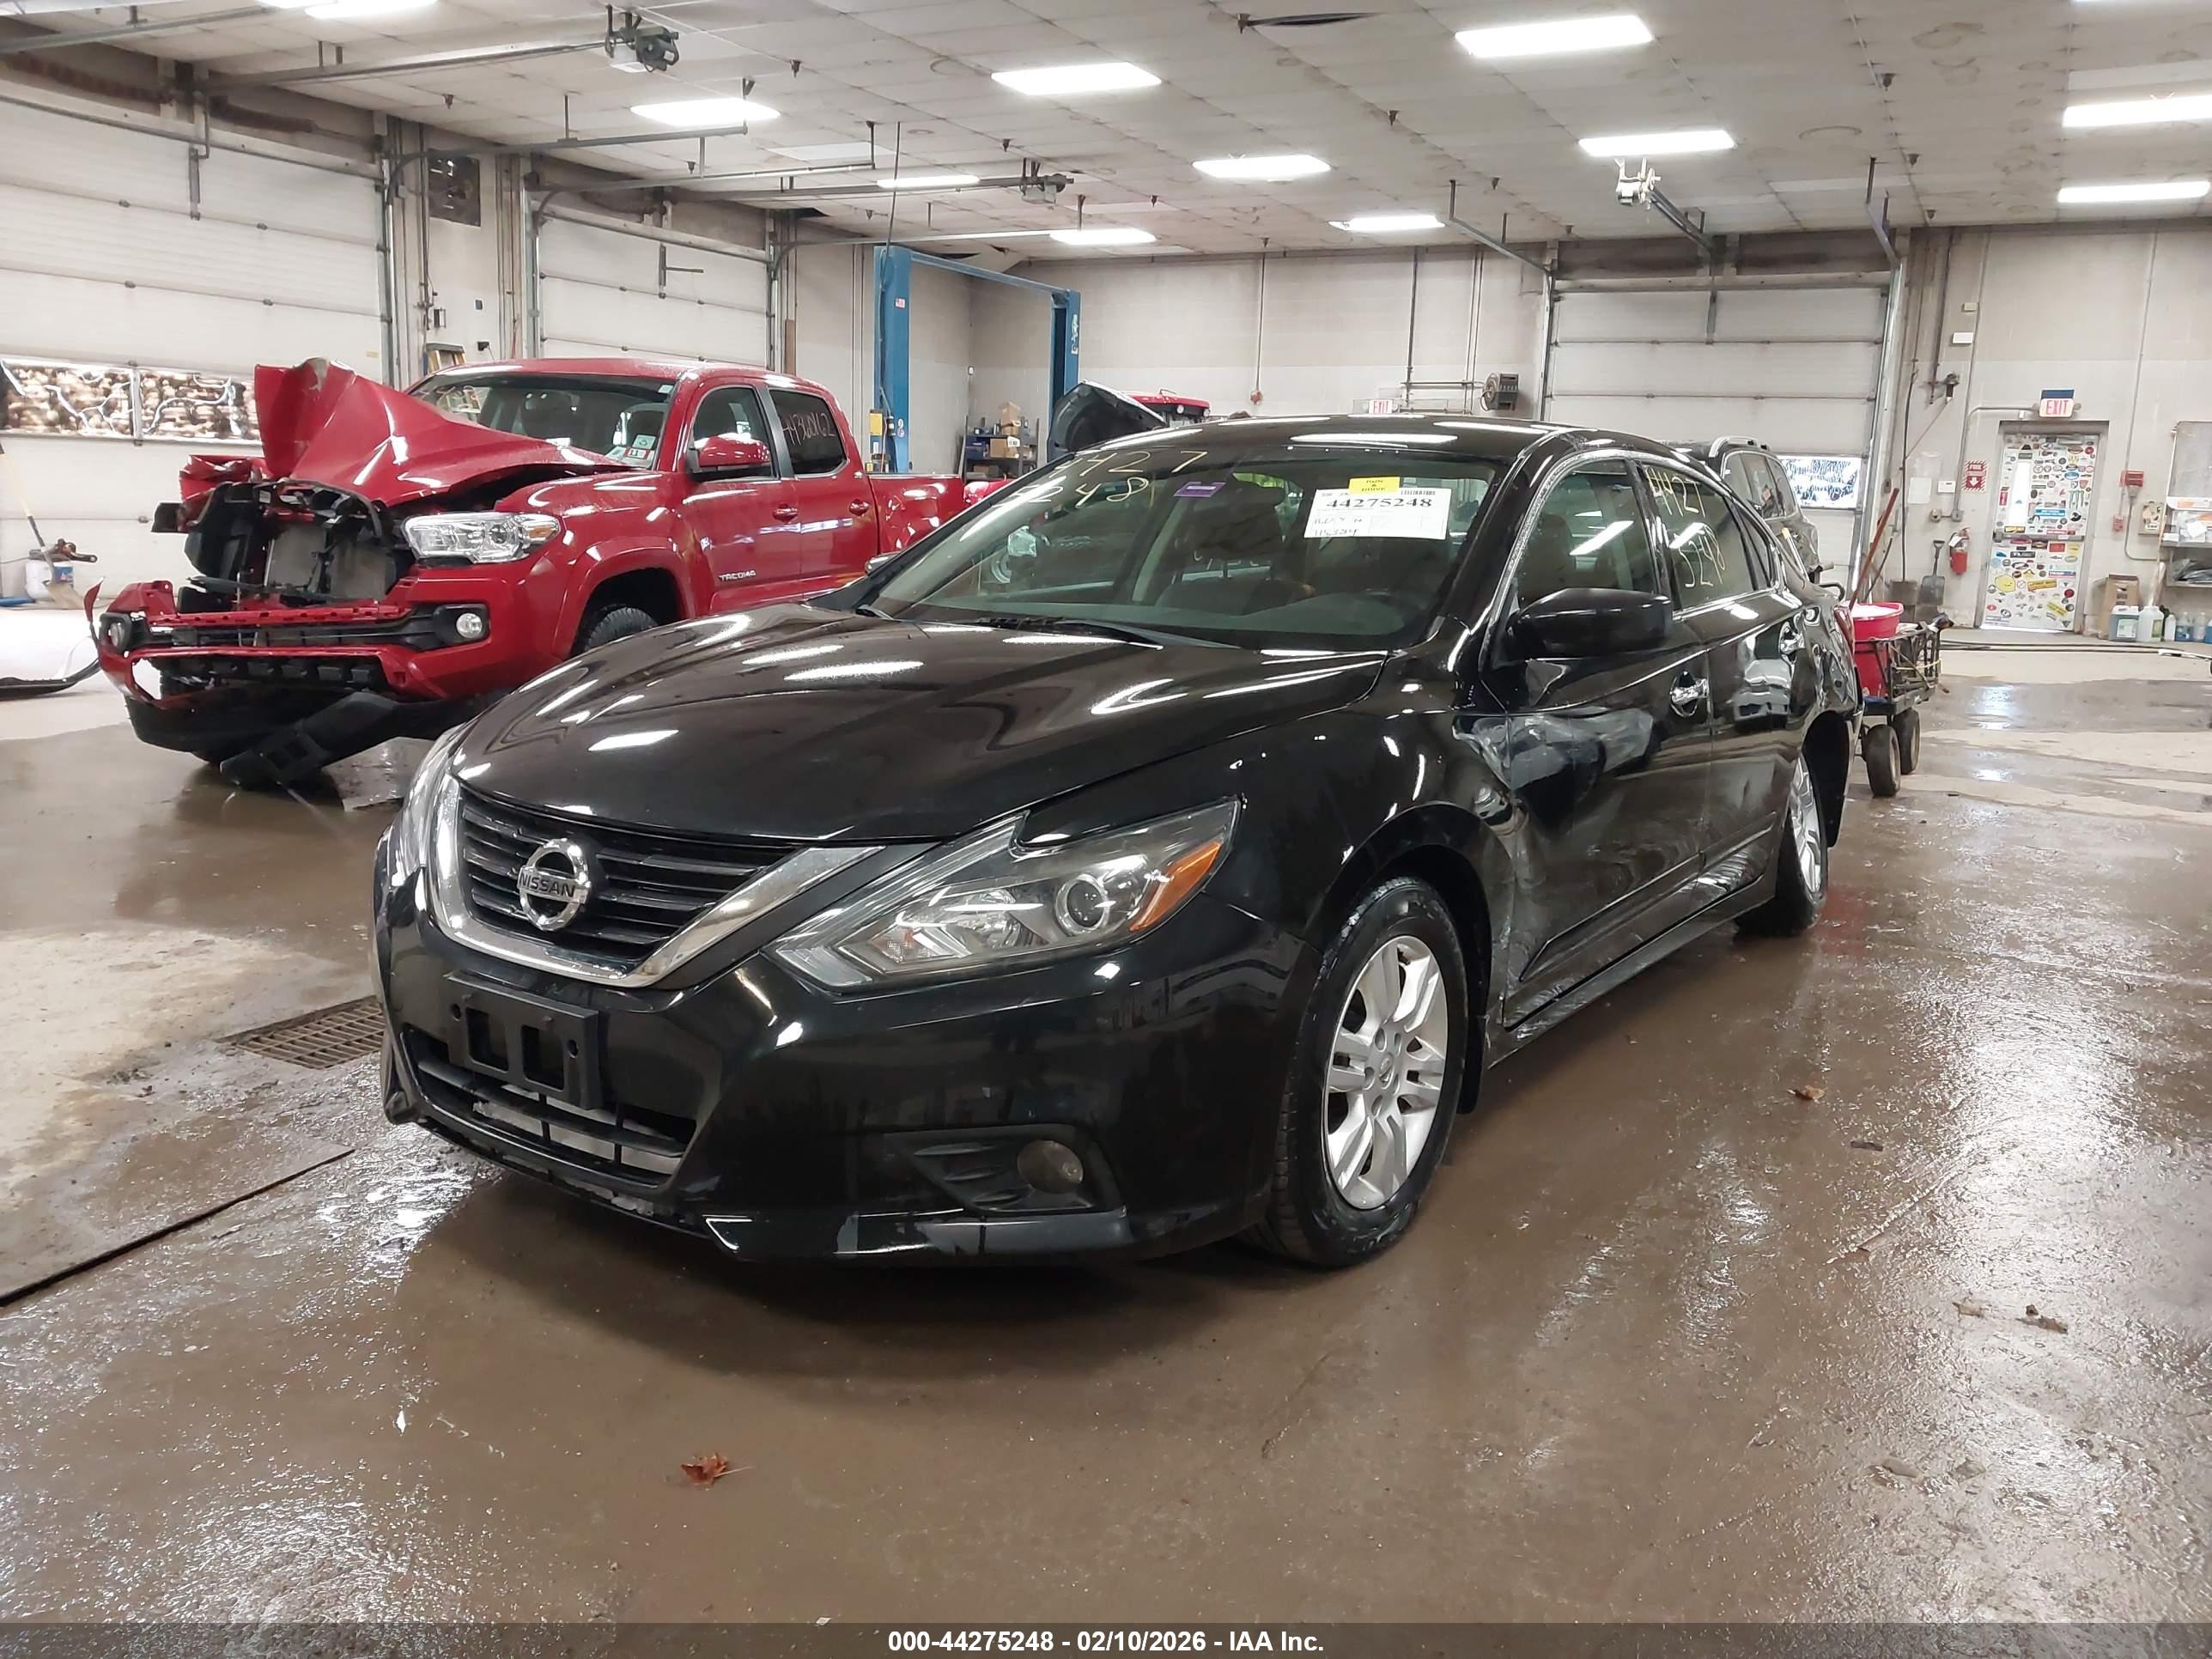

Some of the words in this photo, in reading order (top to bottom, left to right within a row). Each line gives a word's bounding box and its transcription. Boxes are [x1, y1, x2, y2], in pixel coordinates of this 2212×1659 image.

[2046, 399, 2069, 415] EXIT
[1326, 498, 1432, 508] 44275248
[718, 570, 757, 581] TACOMA
[519, 872, 575, 897] NISSAN
